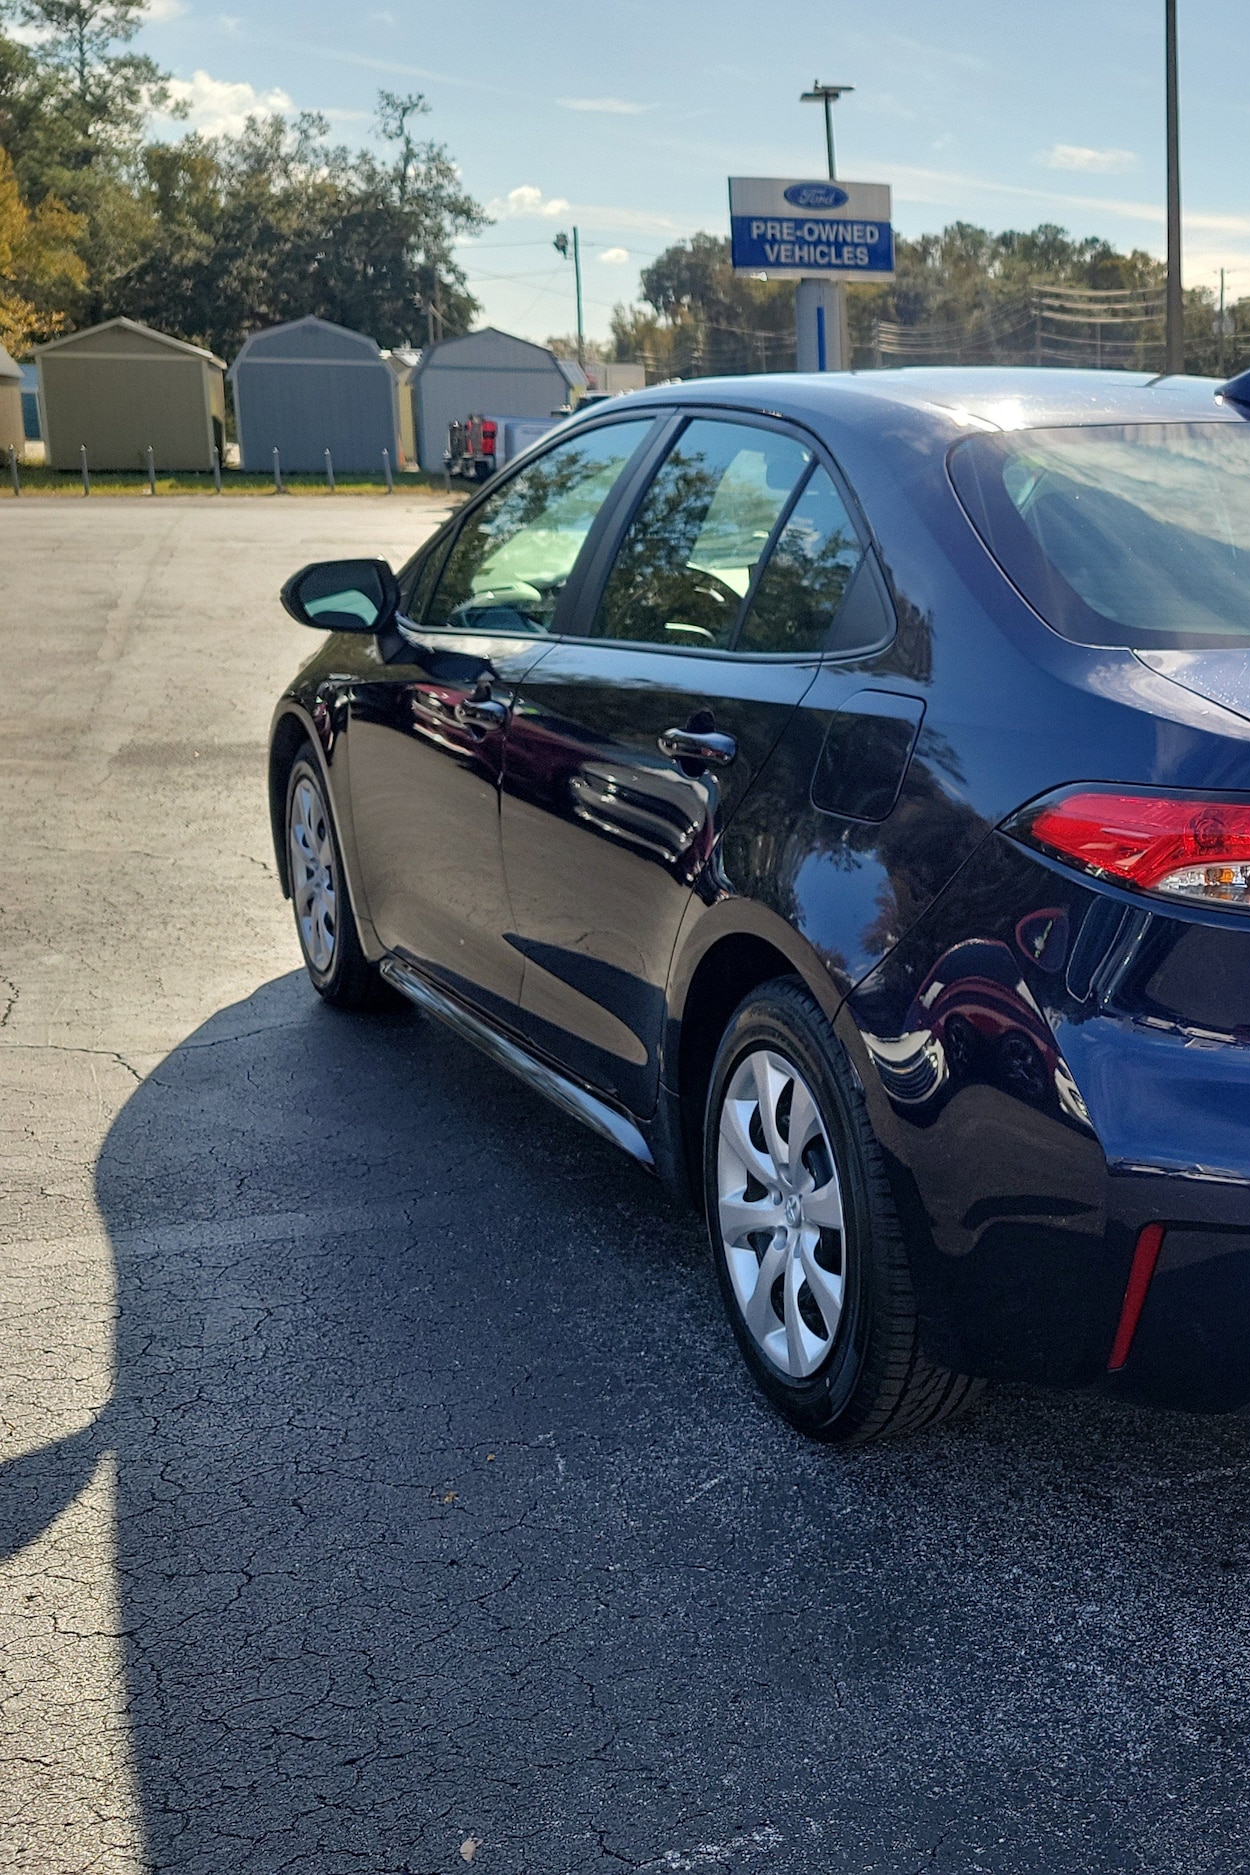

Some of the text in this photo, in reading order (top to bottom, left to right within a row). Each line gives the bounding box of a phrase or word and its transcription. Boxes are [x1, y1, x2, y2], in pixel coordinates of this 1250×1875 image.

[799, 187, 835, 205] Ford
[752, 220, 879, 244] PRE-OWNED
[764, 243, 869, 266] VEHICLES
